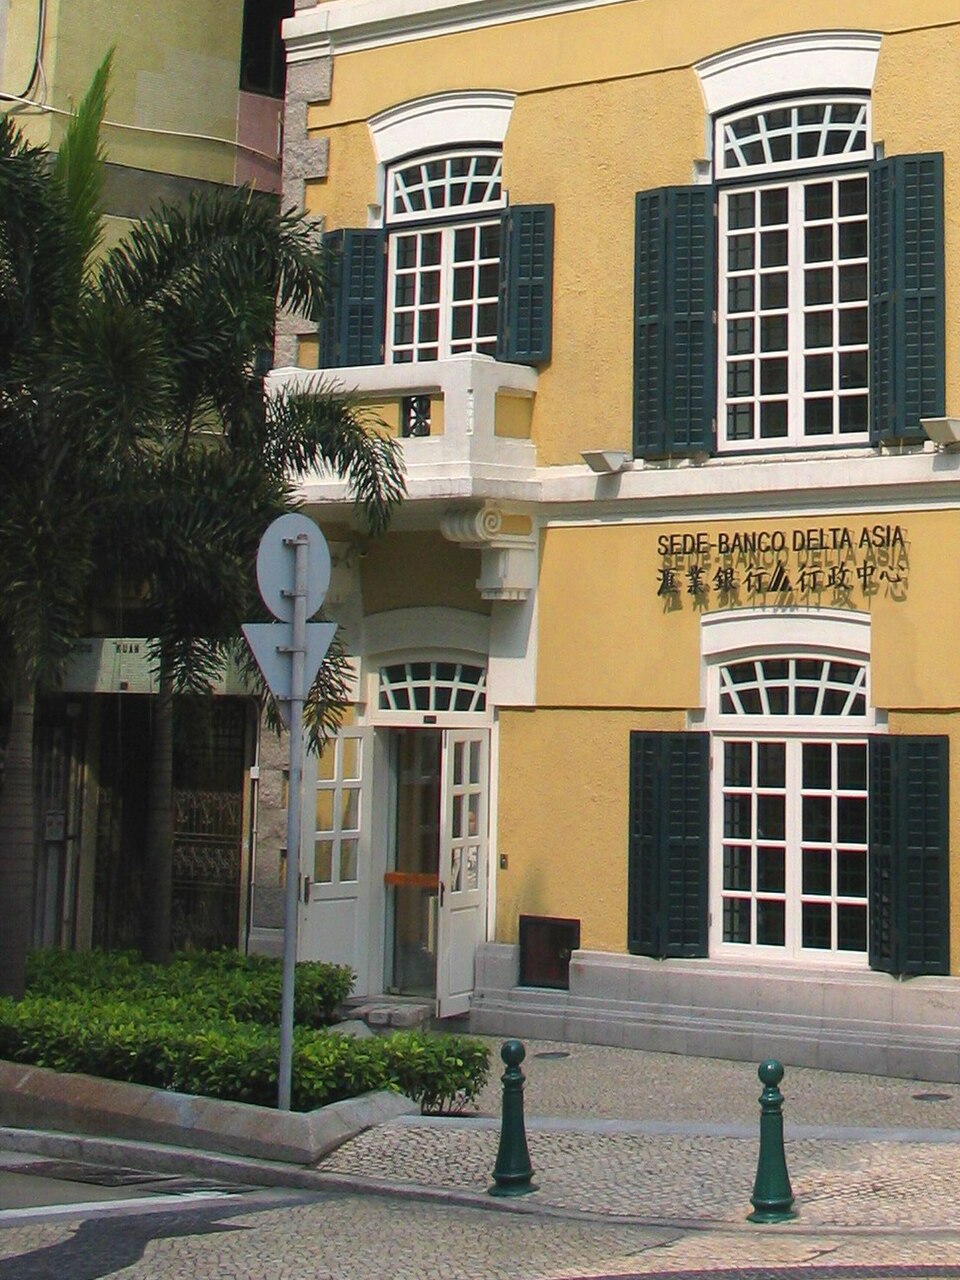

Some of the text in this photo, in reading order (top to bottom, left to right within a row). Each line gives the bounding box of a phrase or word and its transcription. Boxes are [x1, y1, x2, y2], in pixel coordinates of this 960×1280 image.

[657, 525, 905, 556] SEDE-BANCO DELTA ASIA
[797, 559, 903, 593] 行政中心
